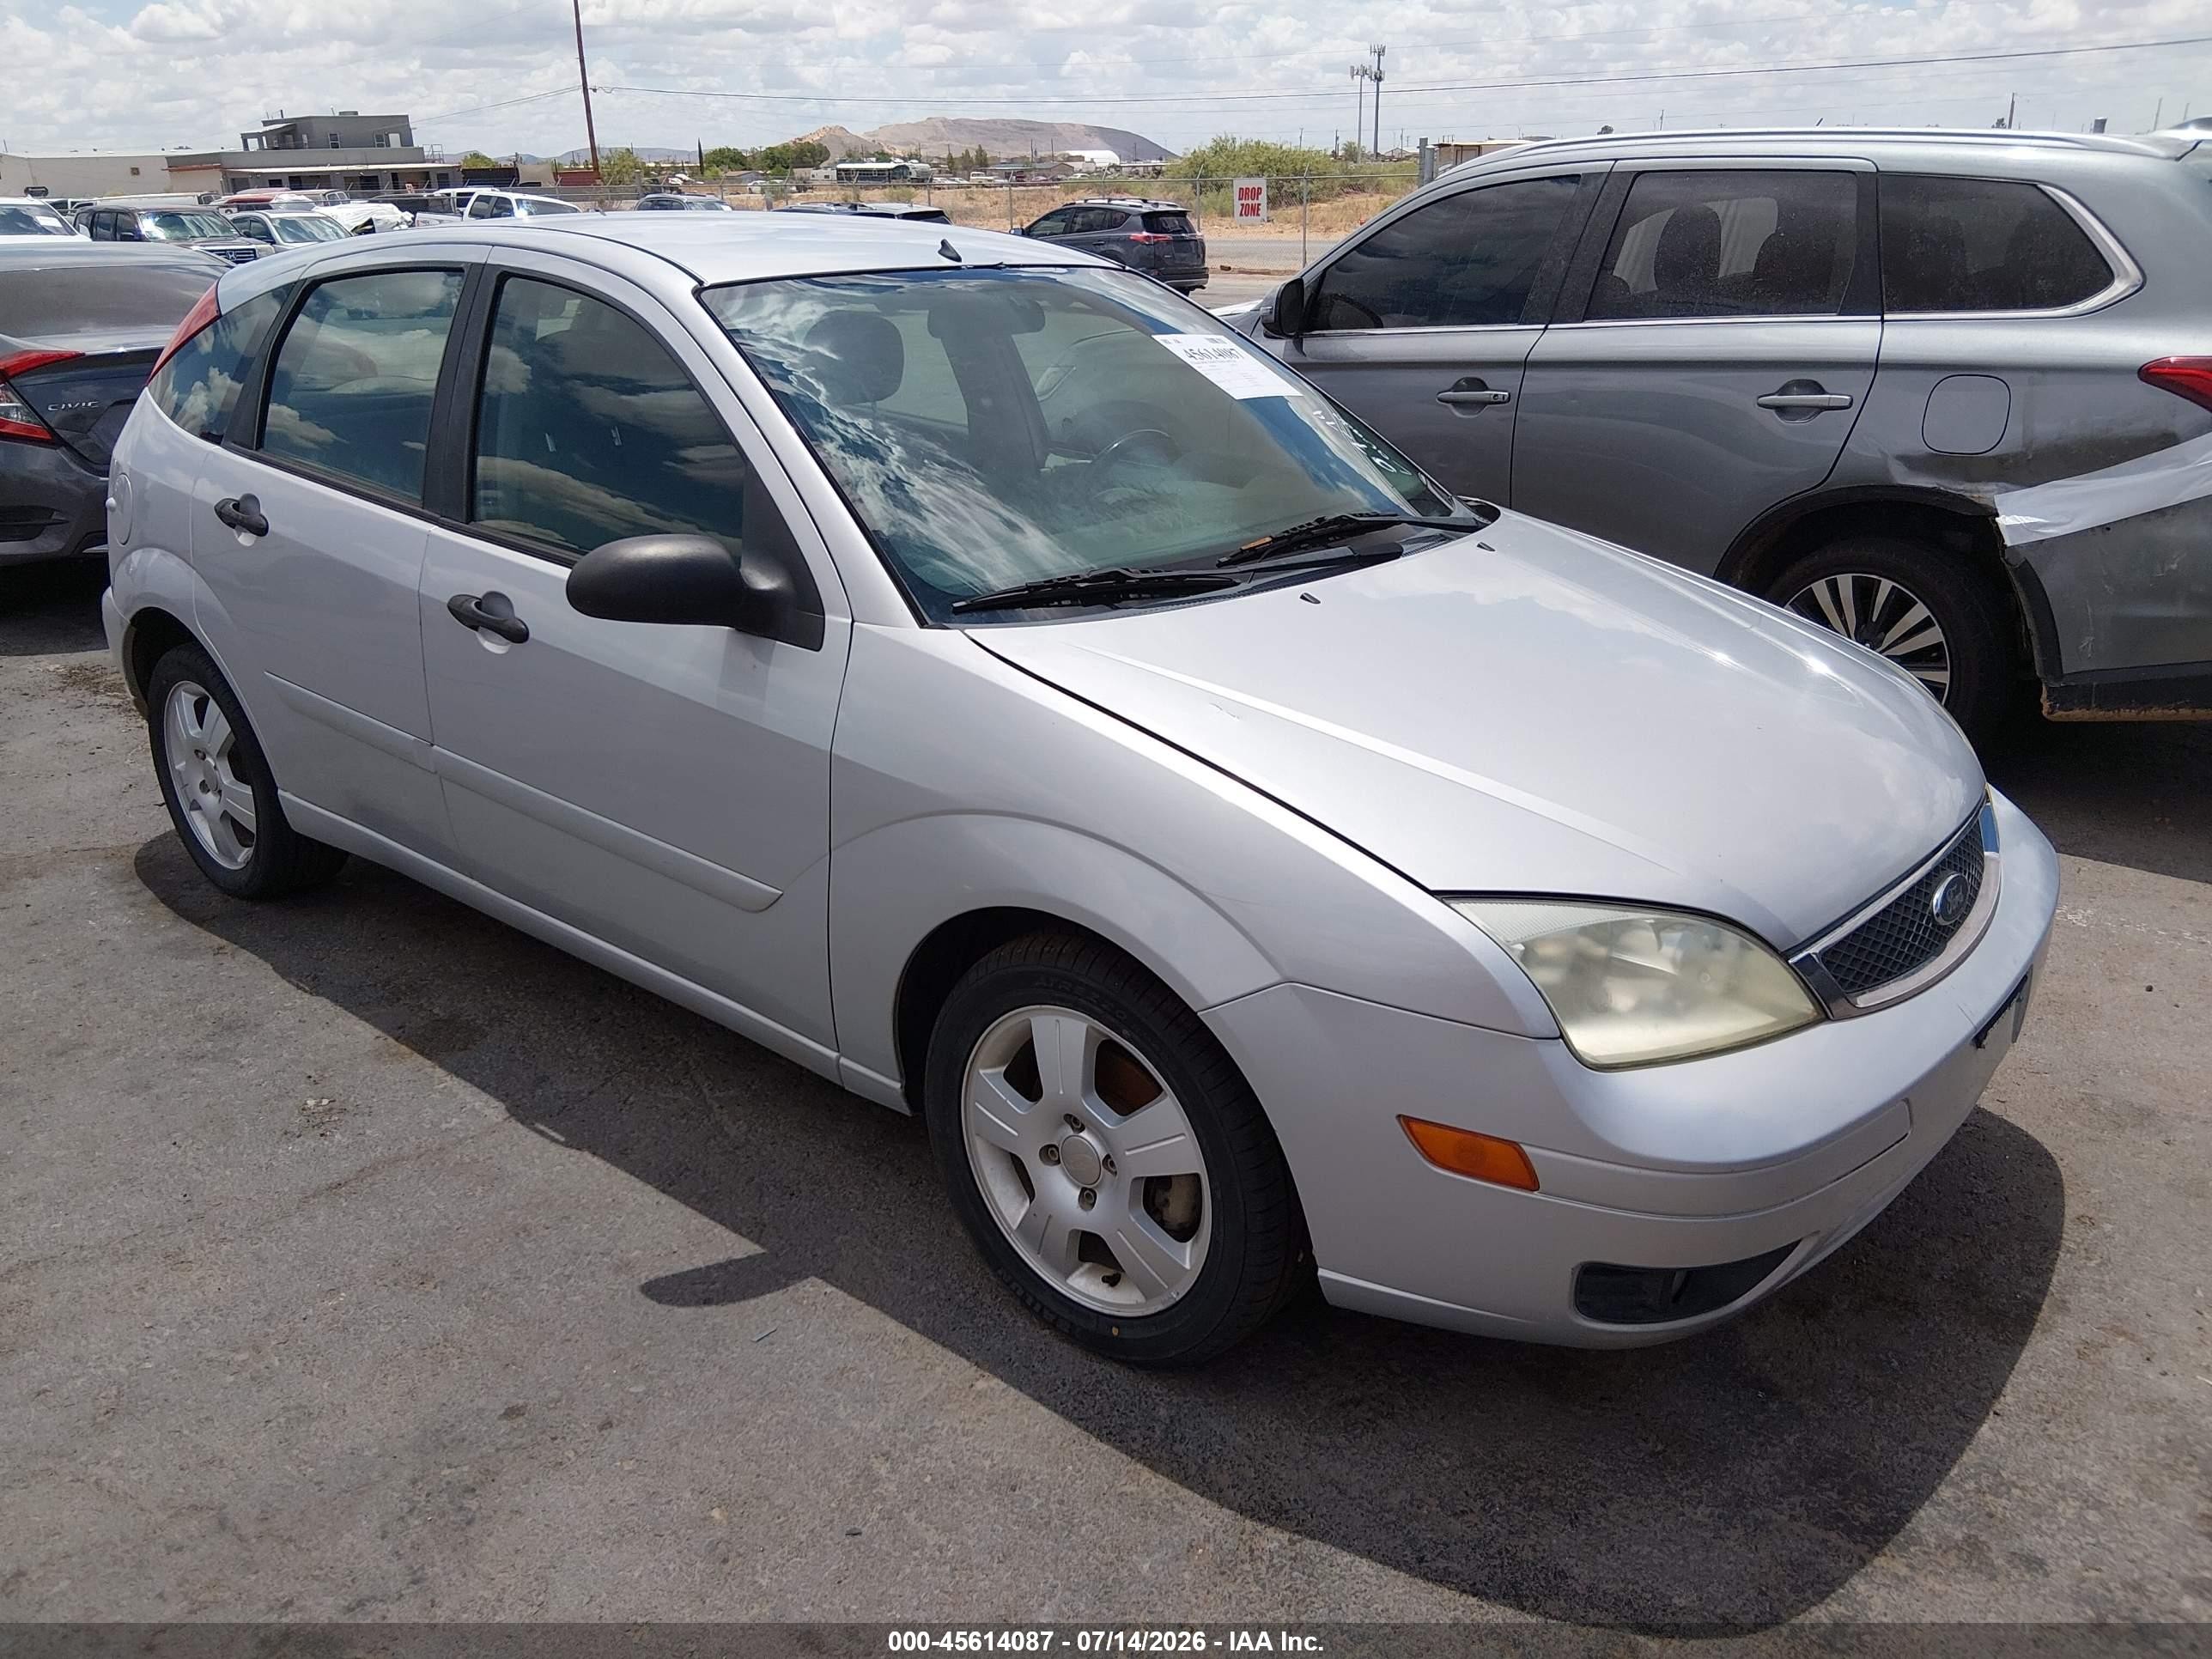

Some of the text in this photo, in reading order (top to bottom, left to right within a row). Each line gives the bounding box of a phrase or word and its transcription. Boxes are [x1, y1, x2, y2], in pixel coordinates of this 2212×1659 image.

[1238, 186, 1262, 201] DROP
[1239, 203, 1261, 217] ZONE
[48, 401, 99, 410] CIVIC
